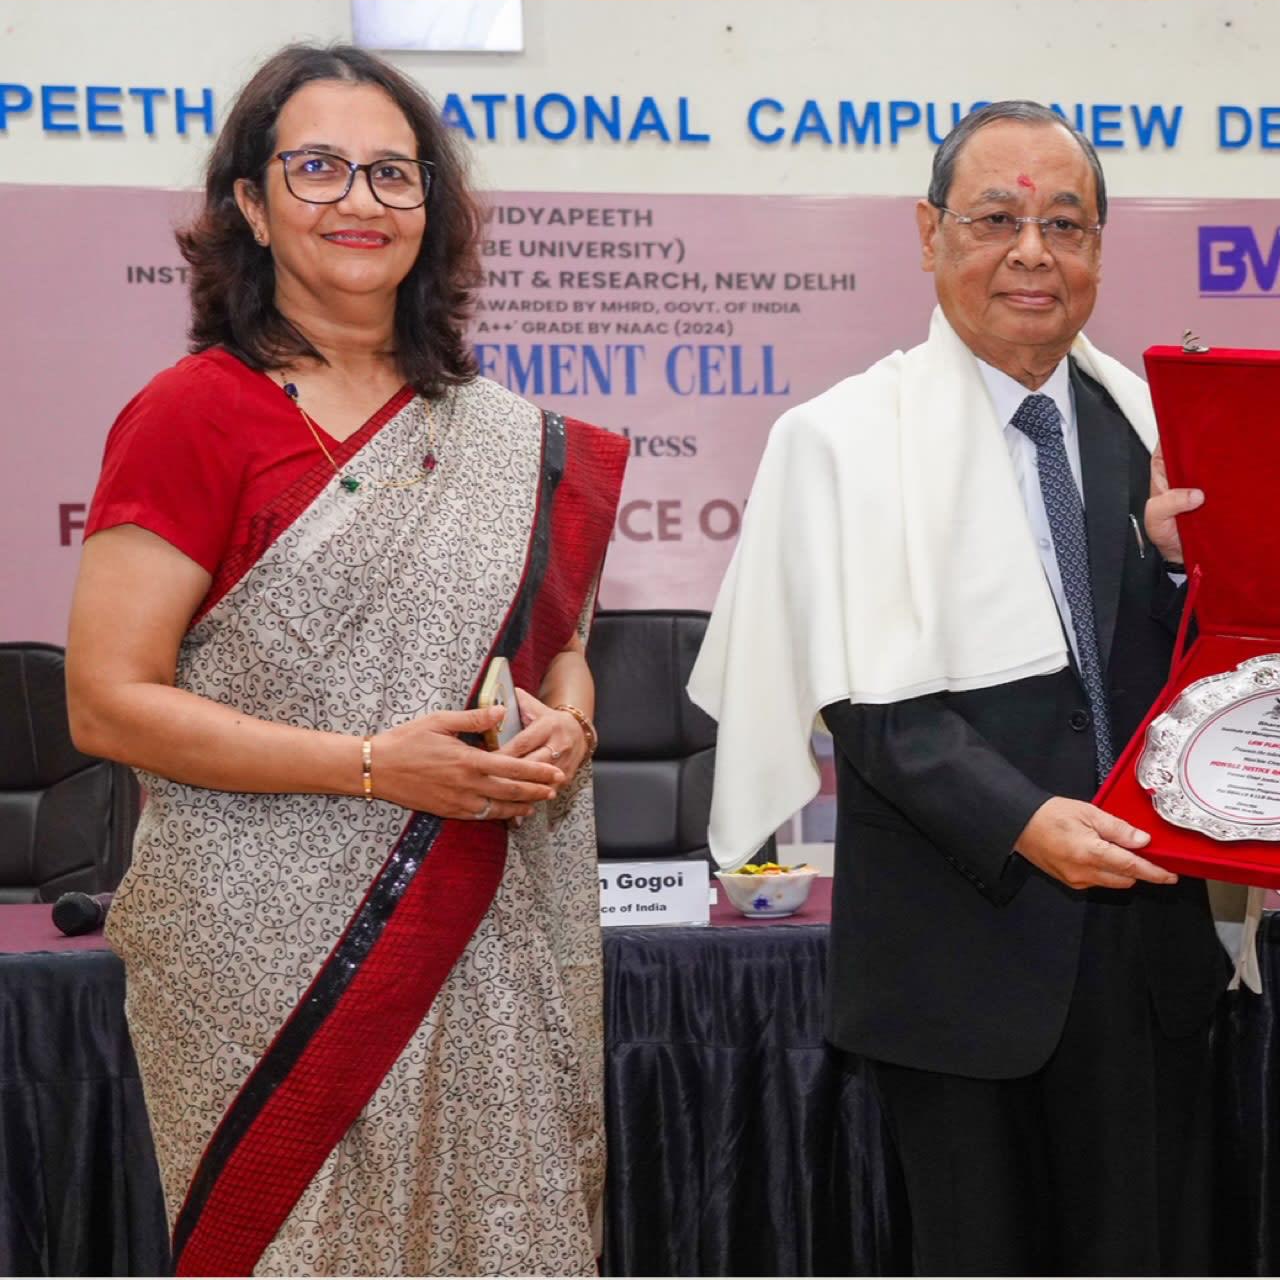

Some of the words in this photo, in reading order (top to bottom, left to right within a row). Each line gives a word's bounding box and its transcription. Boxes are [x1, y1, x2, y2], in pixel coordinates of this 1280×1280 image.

[519, 237, 686, 262] UNIVERSITY)
[531, 271, 552, 289] &
[559, 271, 708, 294] RESEARCH,
[716, 272, 779, 291] NEW
[783, 272, 857, 292] DELHI
[572, 300, 596, 314] BY
[725, 301, 748, 315] OF
[751, 301, 801, 315] INDIA
[521, 321, 585, 336] GRADE
[588, 322, 612, 336] BY
[616, 322, 669, 337] NAAC
[673, 319, 735, 338] (2024)
[666, 343, 791, 397] CELL
[616, 871, 684, 893] Gogoi
[620, 903, 632, 913] of
[635, 902, 667, 913] India
